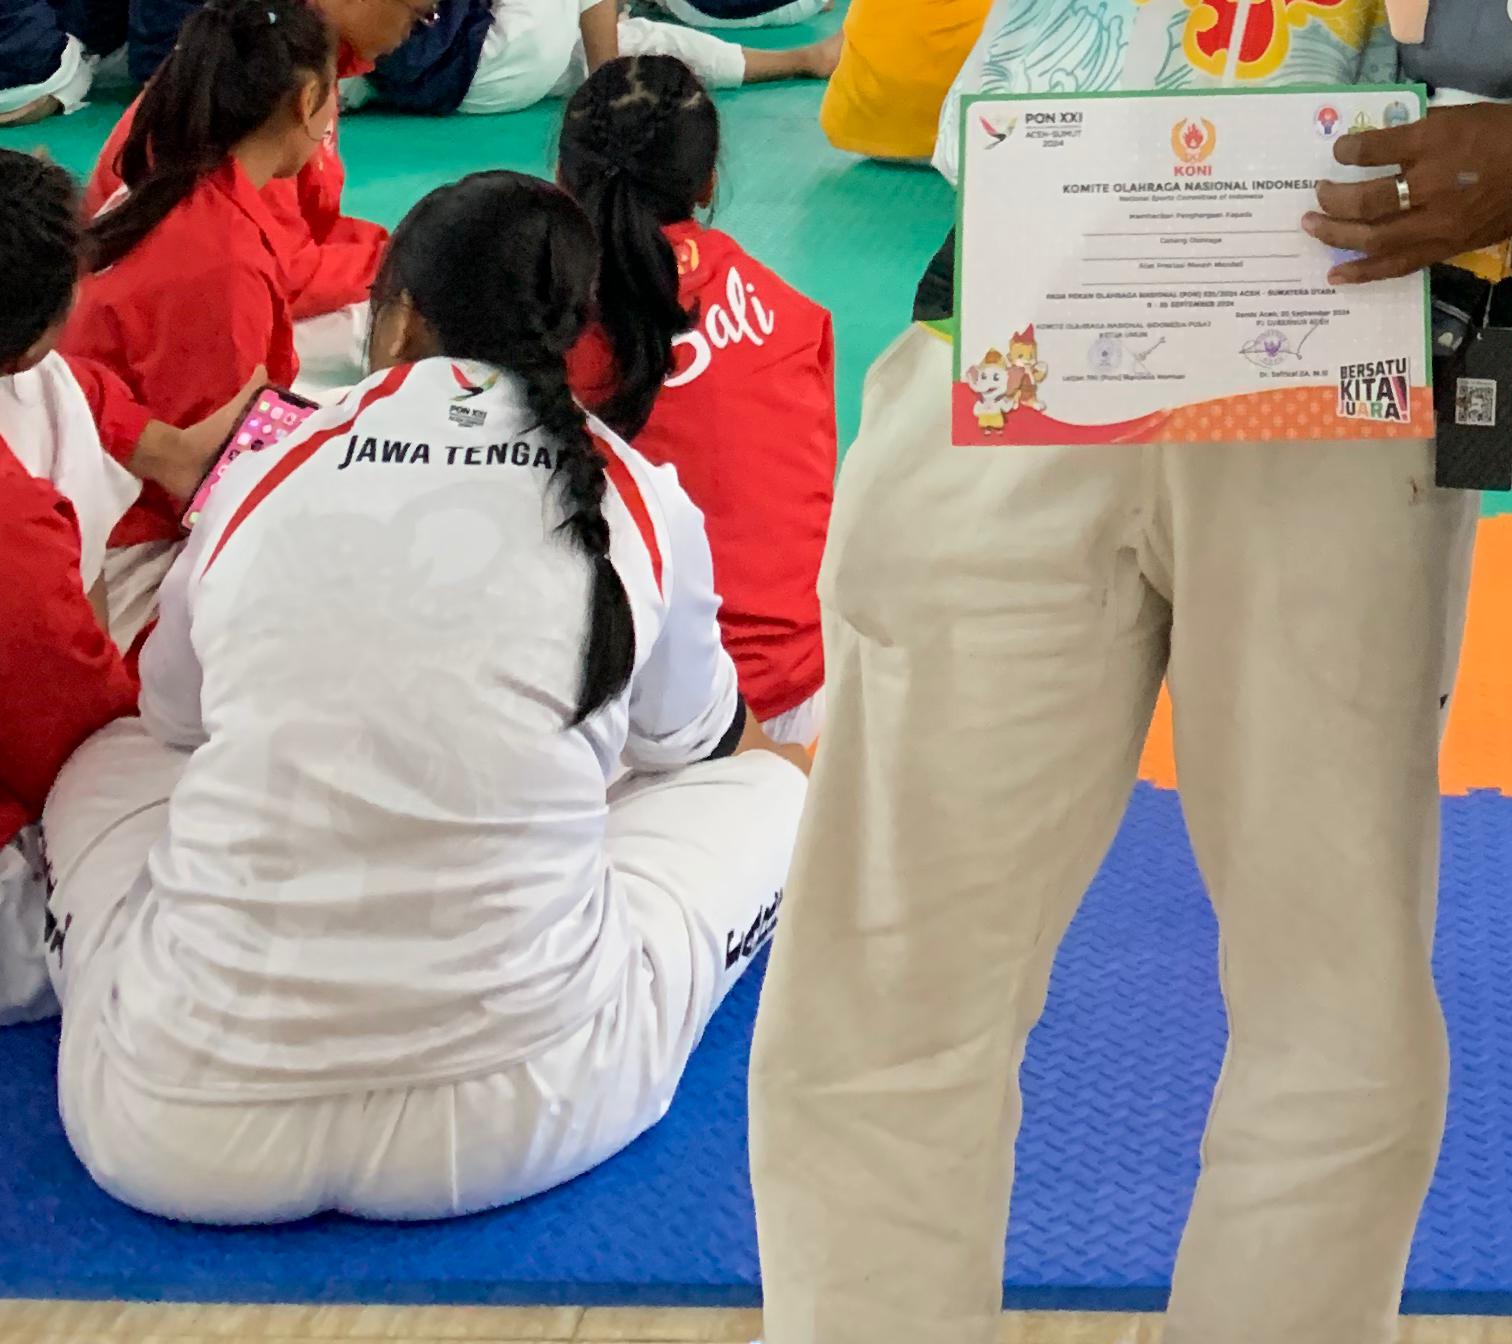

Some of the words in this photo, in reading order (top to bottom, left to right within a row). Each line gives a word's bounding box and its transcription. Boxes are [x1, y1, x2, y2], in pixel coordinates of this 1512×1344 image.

[1025, 113, 1056, 124] PON
[1060, 112, 1083, 123] XXI
[1174, 165, 1212, 177] KONI
[1062, 184, 1109, 194] KOMITE
[1113, 182, 1181, 193] OLAHRAGA
[1184, 181, 1248, 192] NASIONAL
[1340, 357, 1406, 379] BERSATU
[1341, 377, 1394, 402] KITA
[338, 434, 430, 470] JAWA
